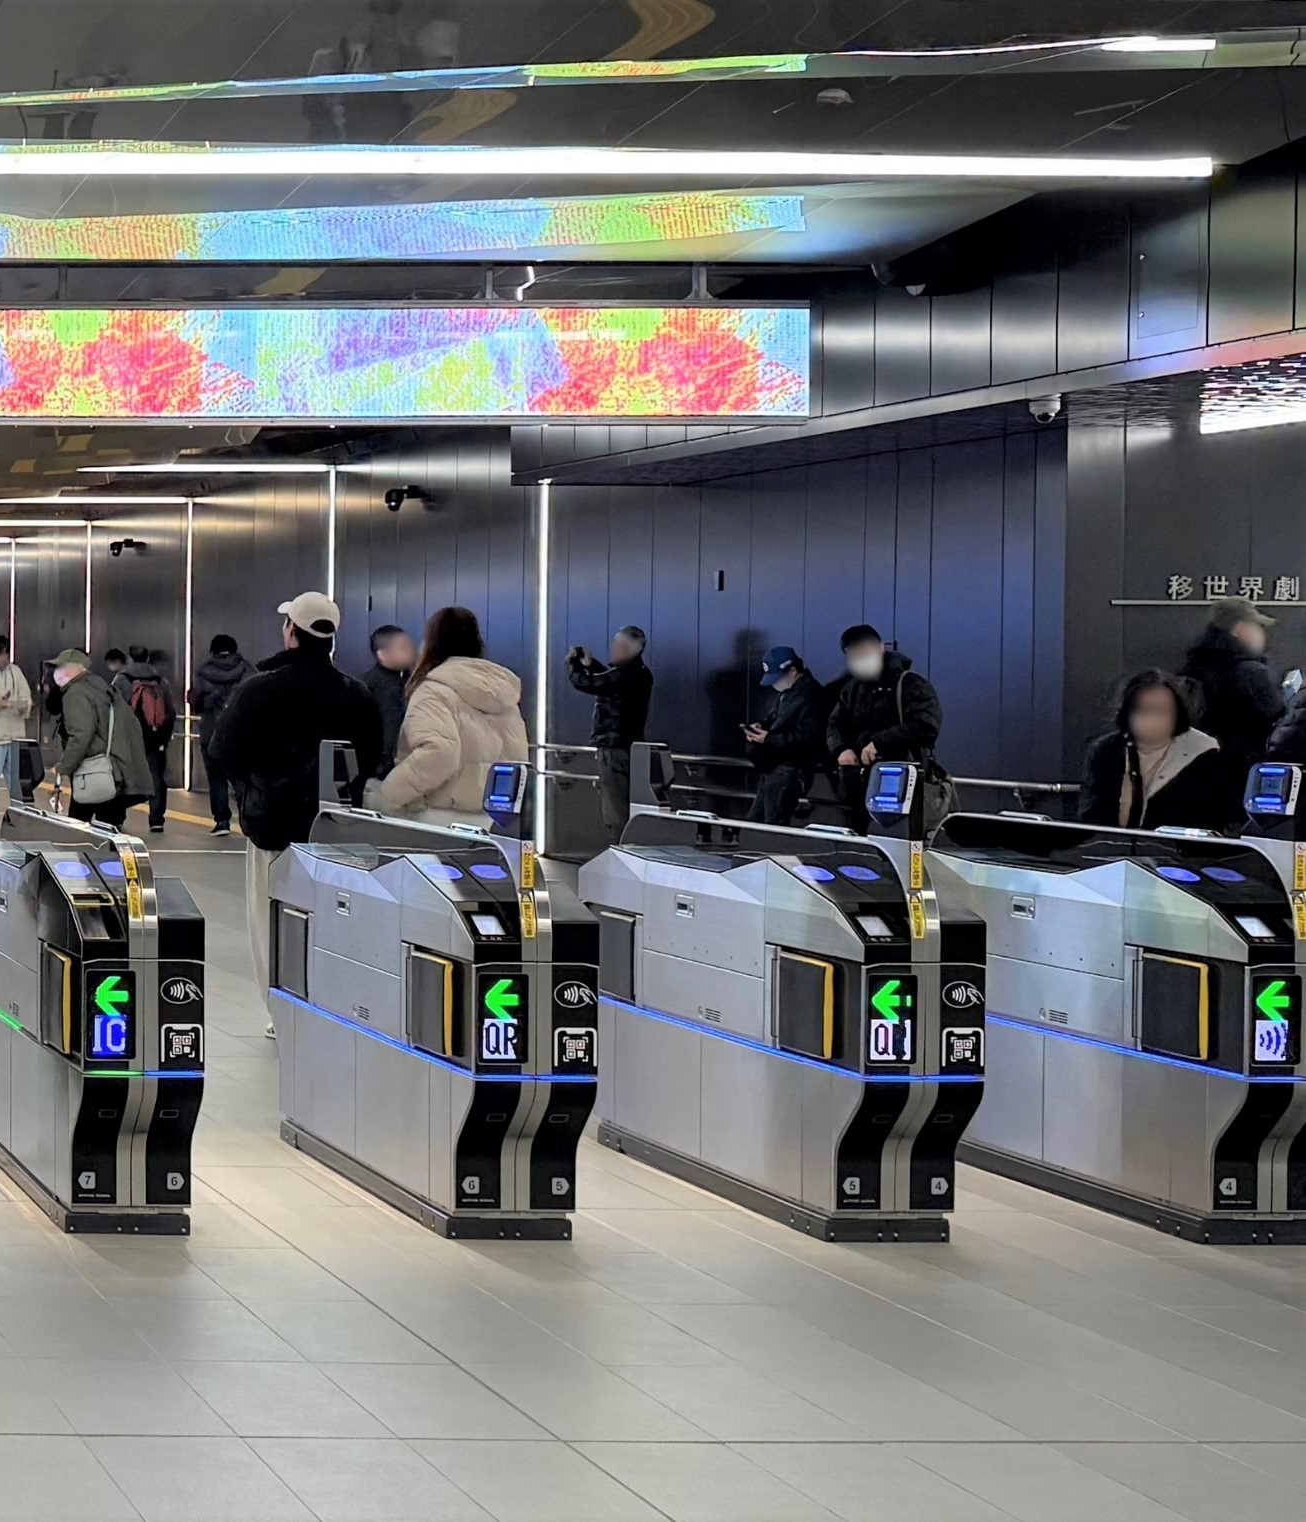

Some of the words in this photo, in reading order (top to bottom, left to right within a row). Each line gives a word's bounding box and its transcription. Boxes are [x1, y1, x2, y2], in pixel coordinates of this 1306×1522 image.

[1167, 574, 1300, 601] 移世界劇
[92, 1017, 127, 1053] IC
[485, 1022, 519, 1056] QR
[84, 1175, 92, 1185] 7
[170, 1176, 178, 1187] 6
[468, 1179, 476, 1191] 6
[849, 1180, 857, 1191] 5
[934, 1180, 942, 1191] 4
[555, 1180, 564, 1192] 5
[1225, 1181, 1233, 1192] 4
